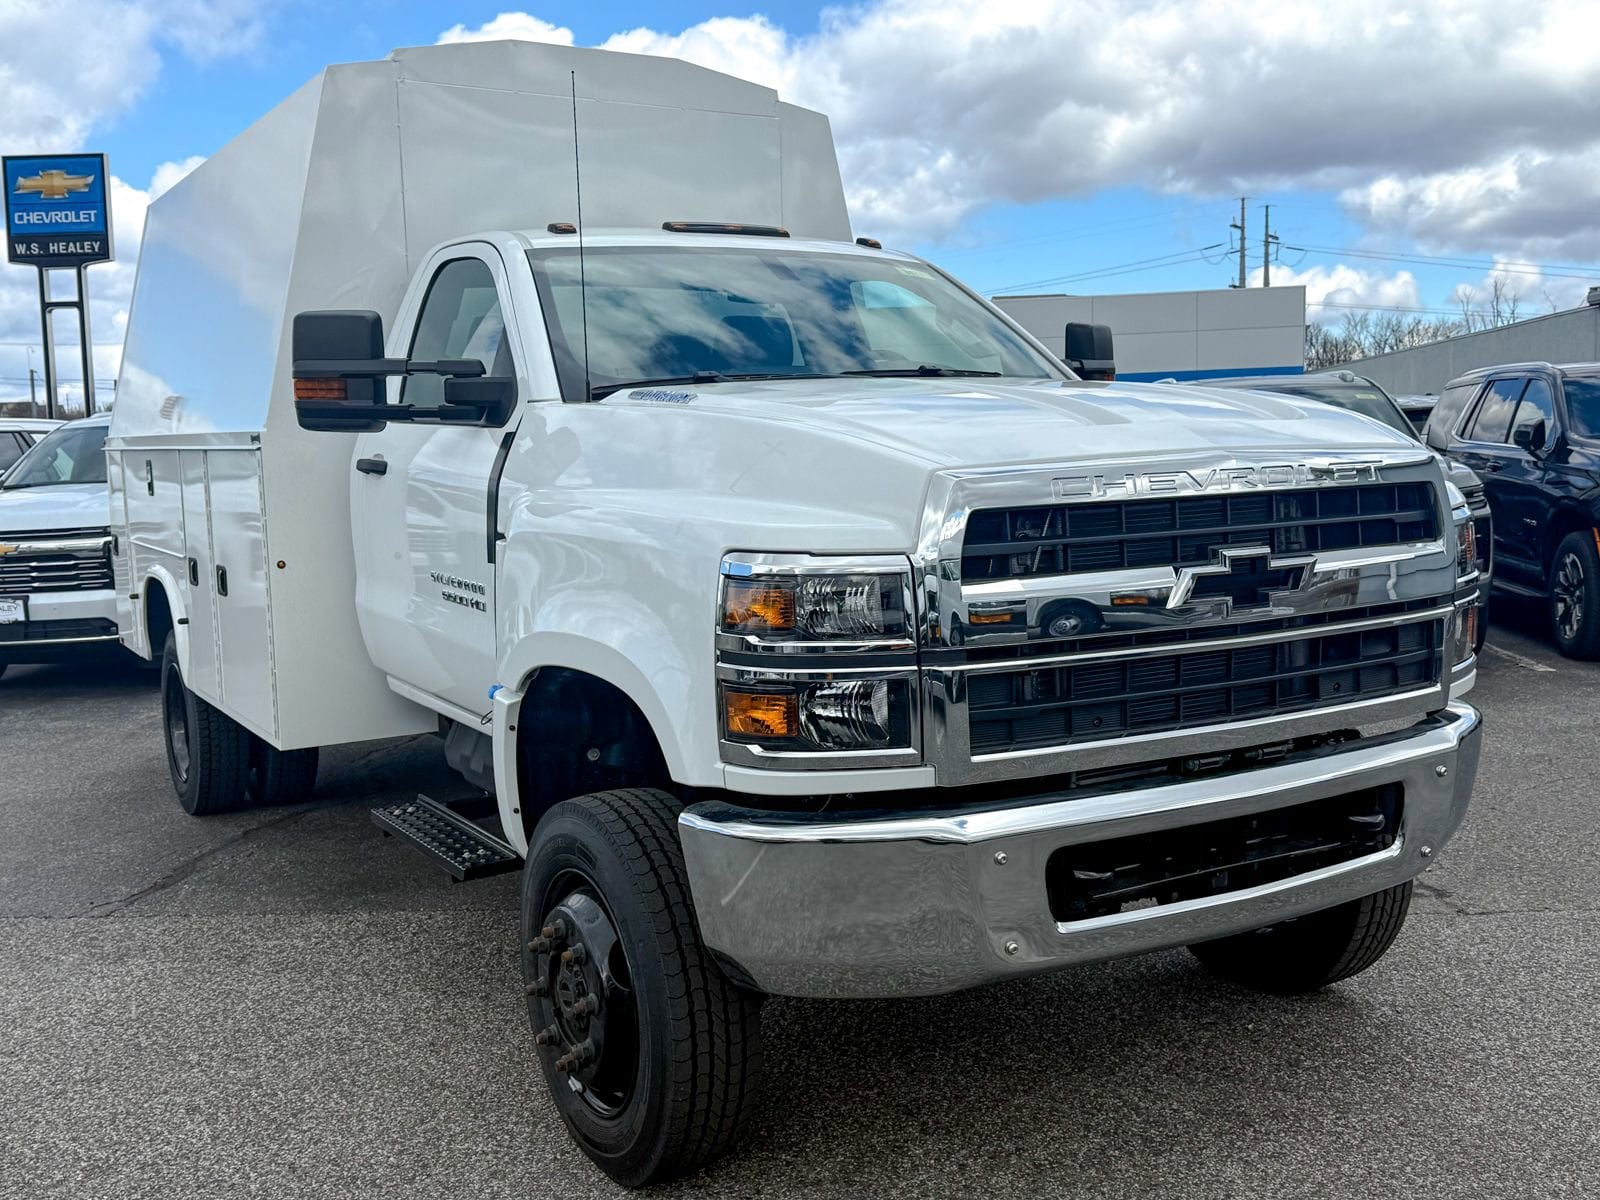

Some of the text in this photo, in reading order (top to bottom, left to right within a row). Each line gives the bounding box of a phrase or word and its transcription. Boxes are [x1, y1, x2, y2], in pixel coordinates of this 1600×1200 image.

[14, 210, 97, 224] CHEVROLET
[15, 241, 100, 254] W.S. HEALEY
[1051, 460, 1384, 499] CHEVROLET
